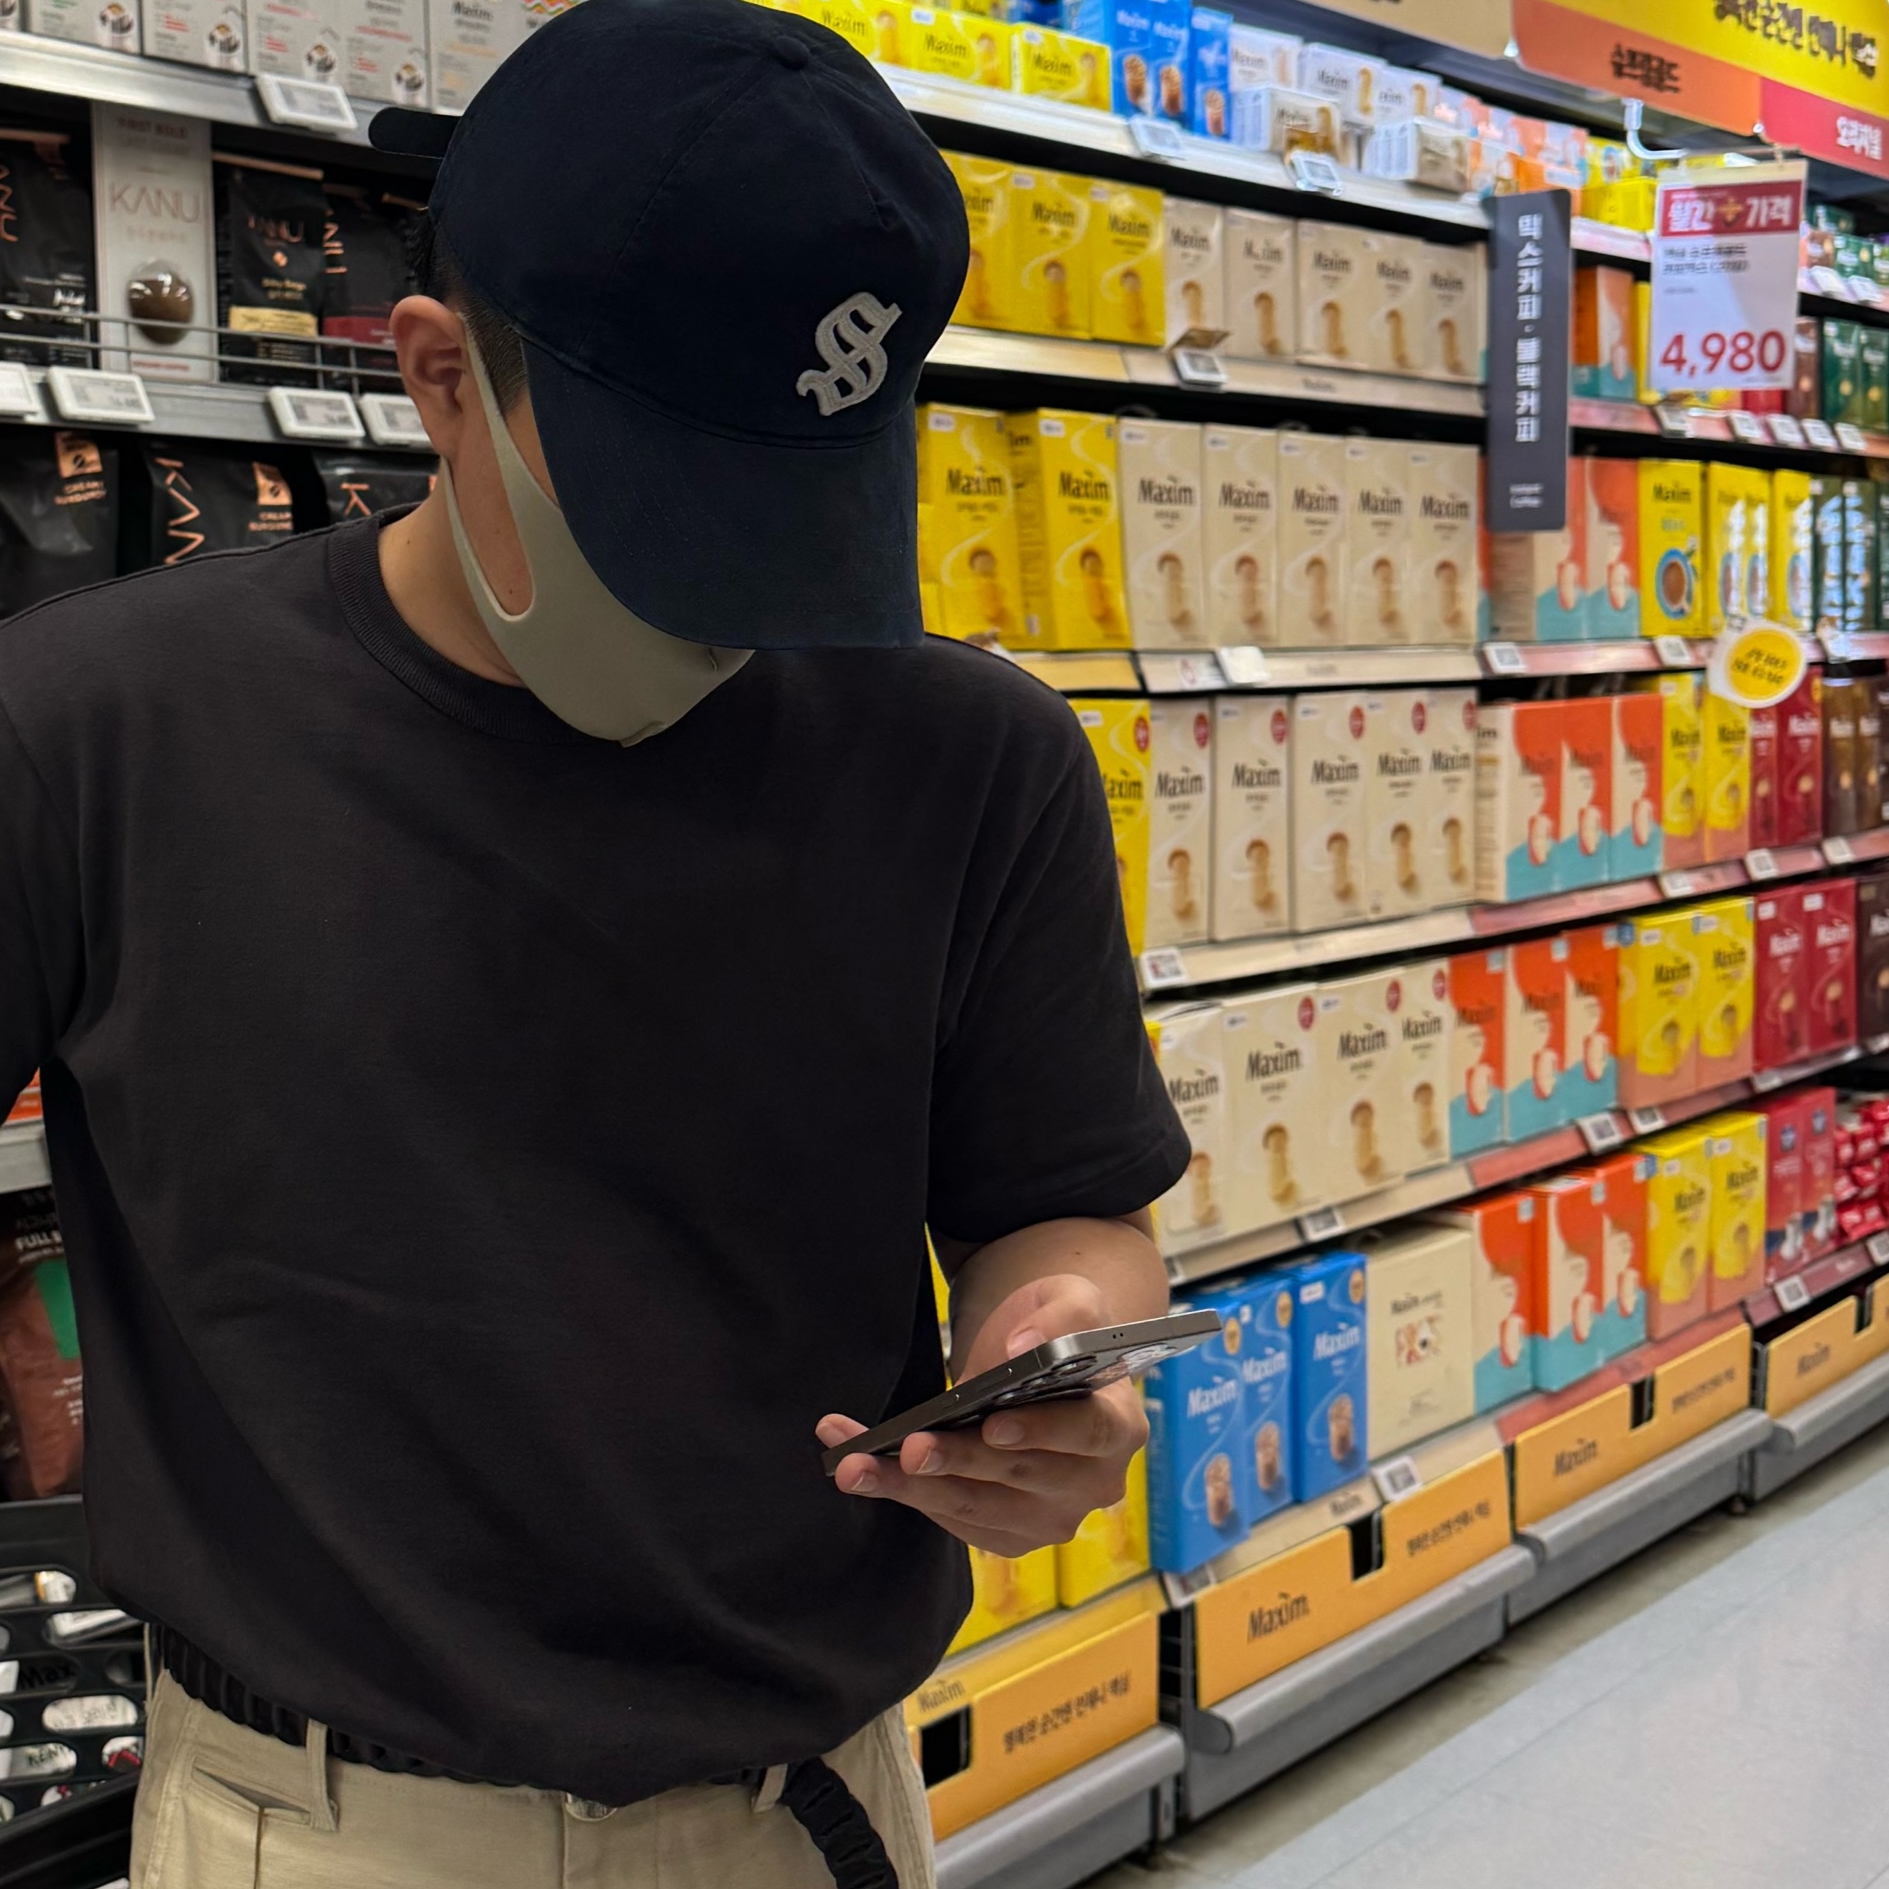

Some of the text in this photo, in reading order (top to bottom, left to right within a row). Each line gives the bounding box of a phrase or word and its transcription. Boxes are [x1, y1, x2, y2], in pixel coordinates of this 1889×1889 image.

[821, 10, 866, 35] Maxim
[924, 33, 968, 58] Maxim
[1032, 51, 1072, 76] Maxim
[108, 182, 201, 223] KANU
[1032, 202, 1075, 227] Maxim
[1108, 213, 1149, 237] Maxim
[1171, 227, 1210, 251] Maxim
[1313, 250, 1352, 273] Maxim
[1377, 258, 1410, 281] Maxim
[1430, 272, 1464, 292] Maxim
[1660, 329, 1786, 378] 4,980
[946, 466, 1002, 496] Maxim
[1059, 471, 1109, 501] Maxim
[1138, 476, 1196, 505] Maxim
[1219, 481, 1270, 510] Maxim
[1653, 480, 1691, 502] Maxim
[1292, 484, 1339, 512] Maxim
[1358, 488, 1402, 515] Maxim
[1420, 493, 1470, 520] Maxim
[1311, 754, 1359, 785] Maxim
[1377, 749, 1421, 777] Maxim
[1429, 745, 1471, 773] Maxim
[1155, 766, 1203, 798] Maxim
[1232, 760, 1281, 789] Maxim
[1713, 942, 1746, 968] Maxim
[1654, 957, 1691, 983] Maxim
[1401, 1012, 1443, 1041] Maxim
[1338, 1024, 1388, 1060] Maxim
[1246, 1042, 1301, 1081] Maxim
[1168, 1069, 1219, 1104] Maxim
[1313, 1322, 1360, 1361] Maxim
[1242, 1347, 1287, 1384] Maxim
[1187, 1376, 1237, 1418] Maxim
[1554, 1437, 1599, 1477] Maxim
[1247, 1591, 1310, 1643] Maxim
[917, 1679, 965, 1712] Maxim
